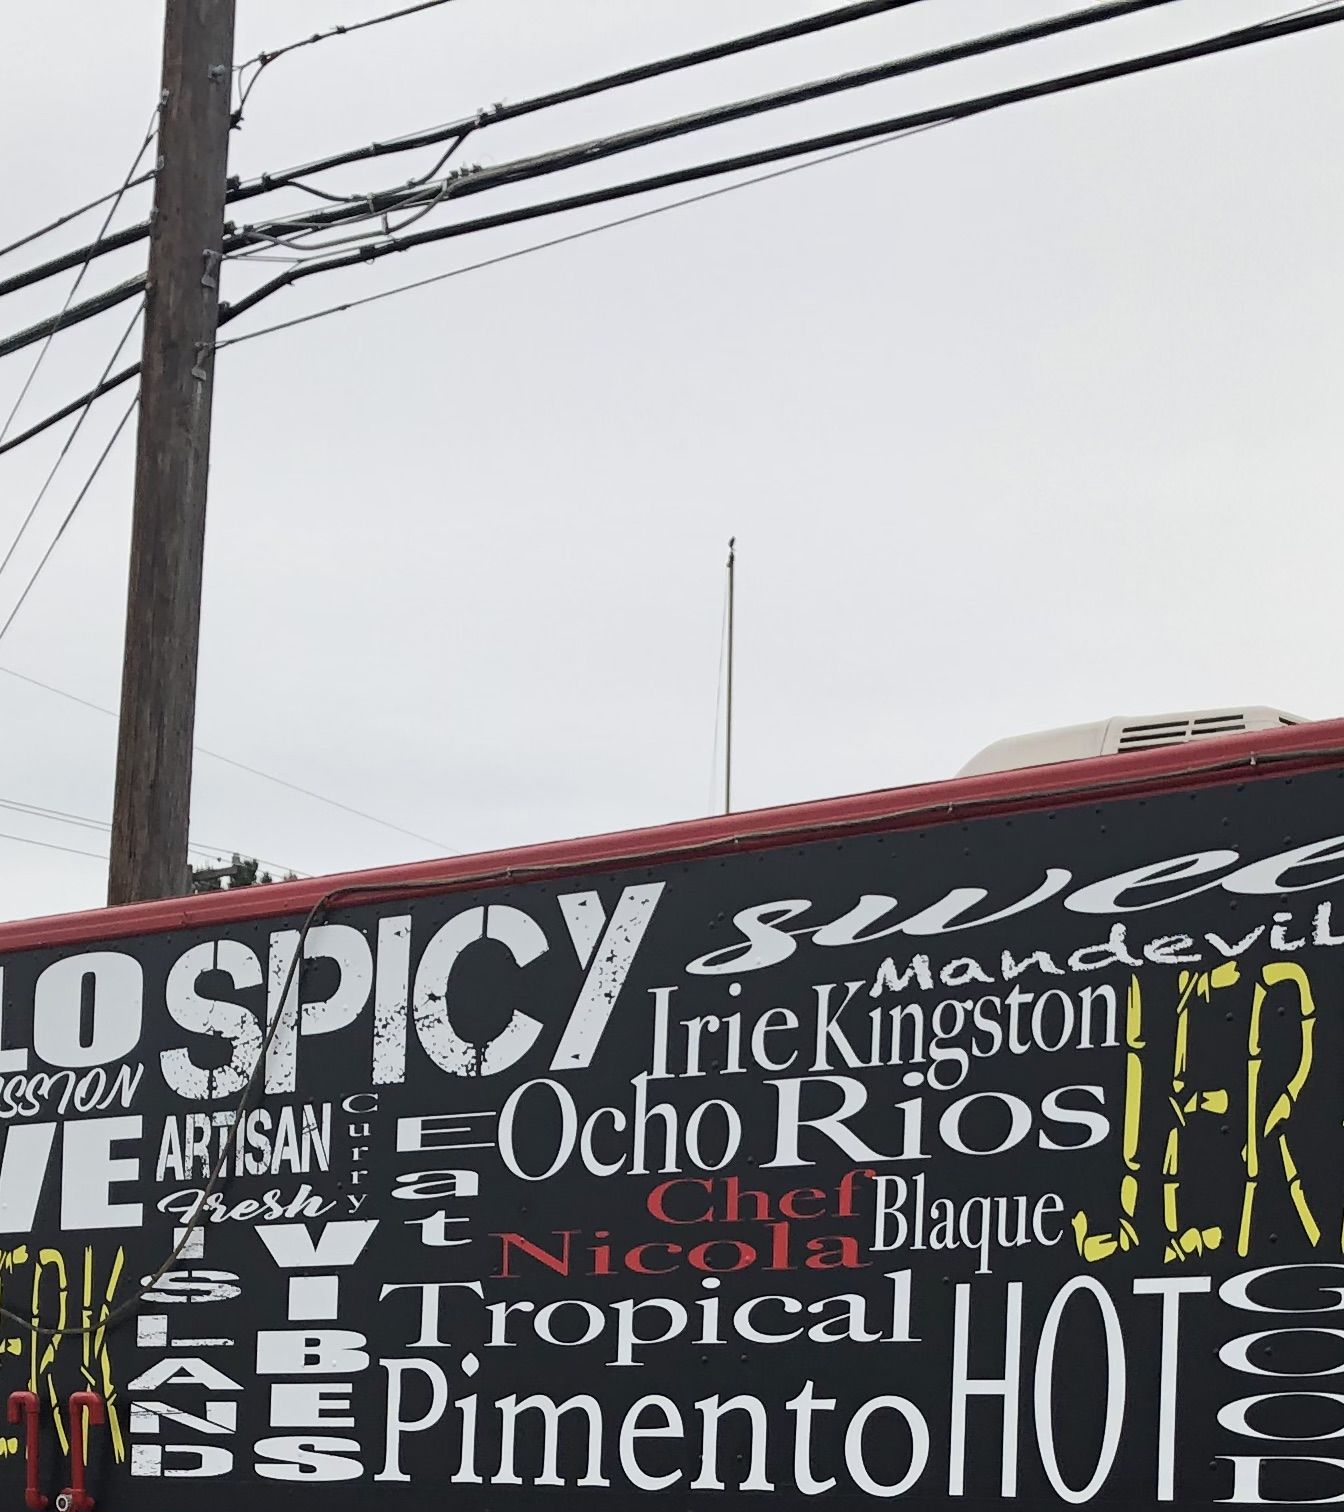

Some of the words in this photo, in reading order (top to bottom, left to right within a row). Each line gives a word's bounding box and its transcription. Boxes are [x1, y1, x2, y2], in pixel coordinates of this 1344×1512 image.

[159, 882, 665, 1099] SPICY
[649, 984, 799, 1080] Irie
[813, 976, 1120, 1092] Kingston
[156, 1102, 331, 1181] ARTISAN
[342, 1093, 379, 1214] Curry
[391, 1111, 498, 1247] Eat
[498, 1071, 742, 1181] Ocho
[763, 1072, 1111, 1170] Rios
[157, 1184, 343, 1225] Fresh
[499, 1221, 875, 1279] Nicola
[646, 1167, 877, 1227] Chef
[870, 1176, 1066, 1273] Blaque
[128, 1226, 244, 1478] ISLAND
[255, 1219, 379, 1482] VIBES
[378, 1270, 922, 1367] Tropical
[373, 1352, 930, 1498] Pimento
[949, 1275, 1211, 1504] HOT
